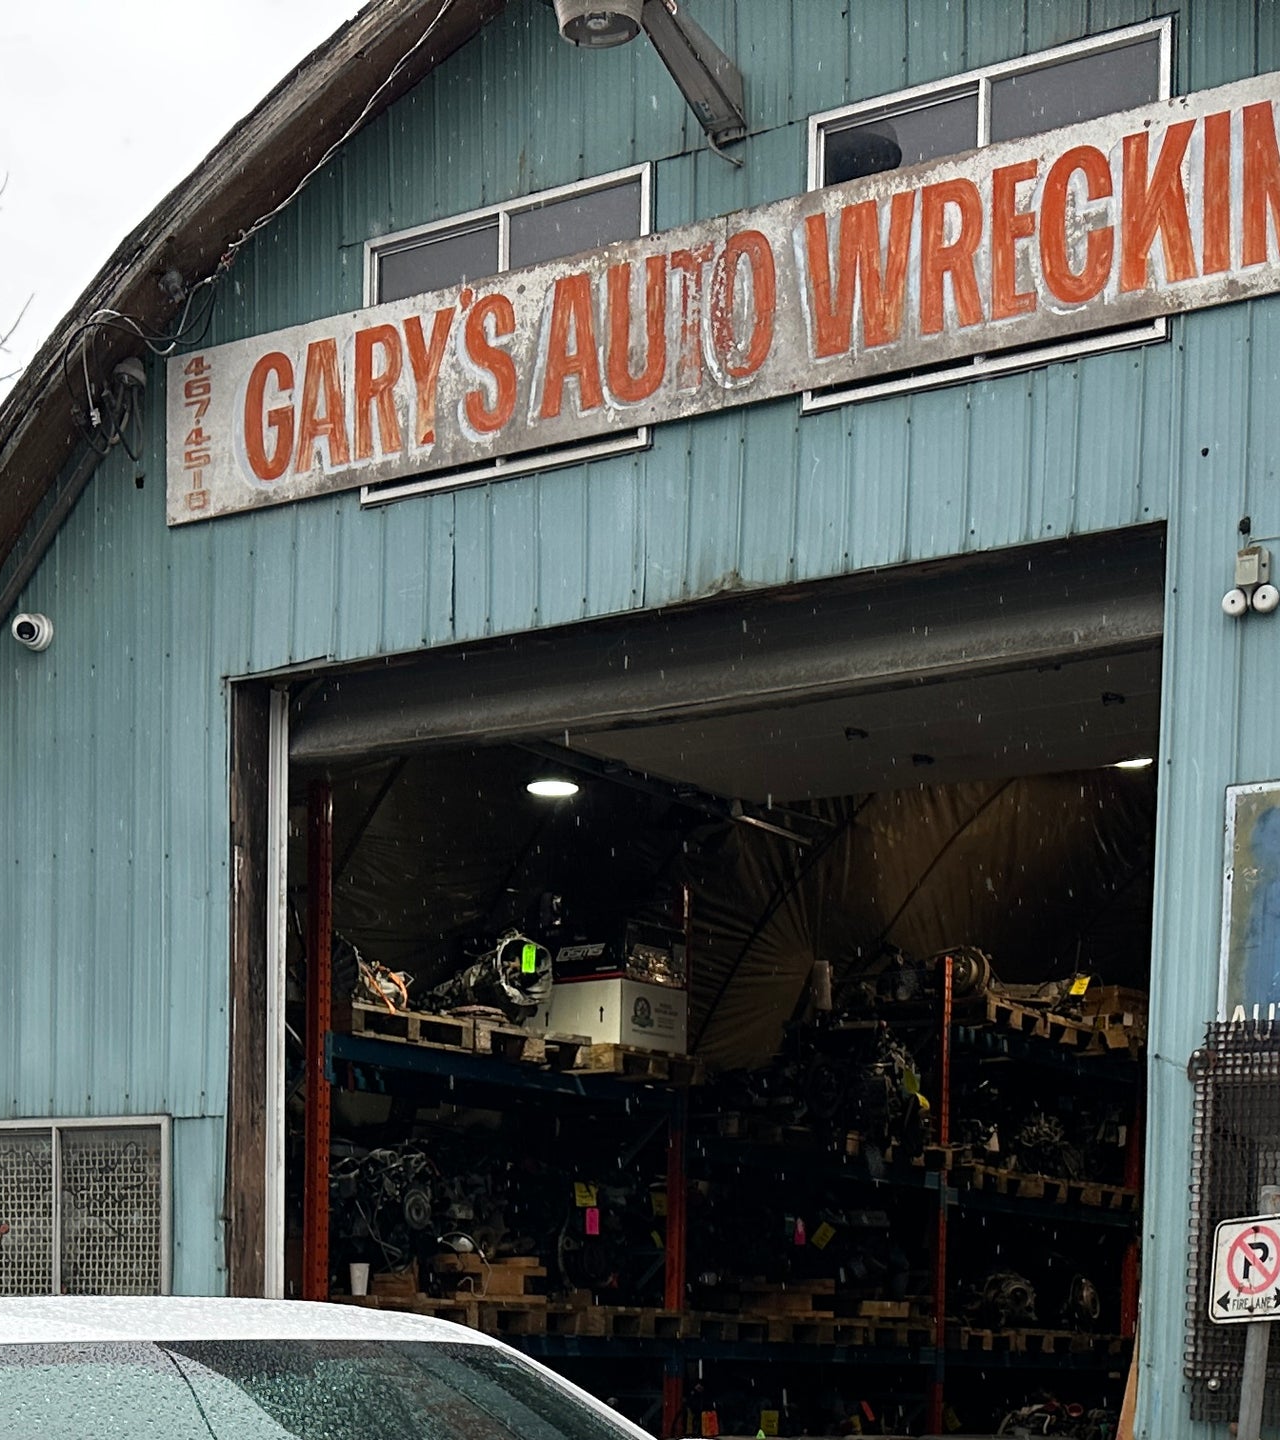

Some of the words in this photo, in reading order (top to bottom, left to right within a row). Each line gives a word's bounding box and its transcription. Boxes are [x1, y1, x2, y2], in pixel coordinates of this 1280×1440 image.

[242, 287, 517, 482] GARY'S
[538, 229, 777, 418] AUTO
[1231, 1297, 1249, 1310] FIRE
